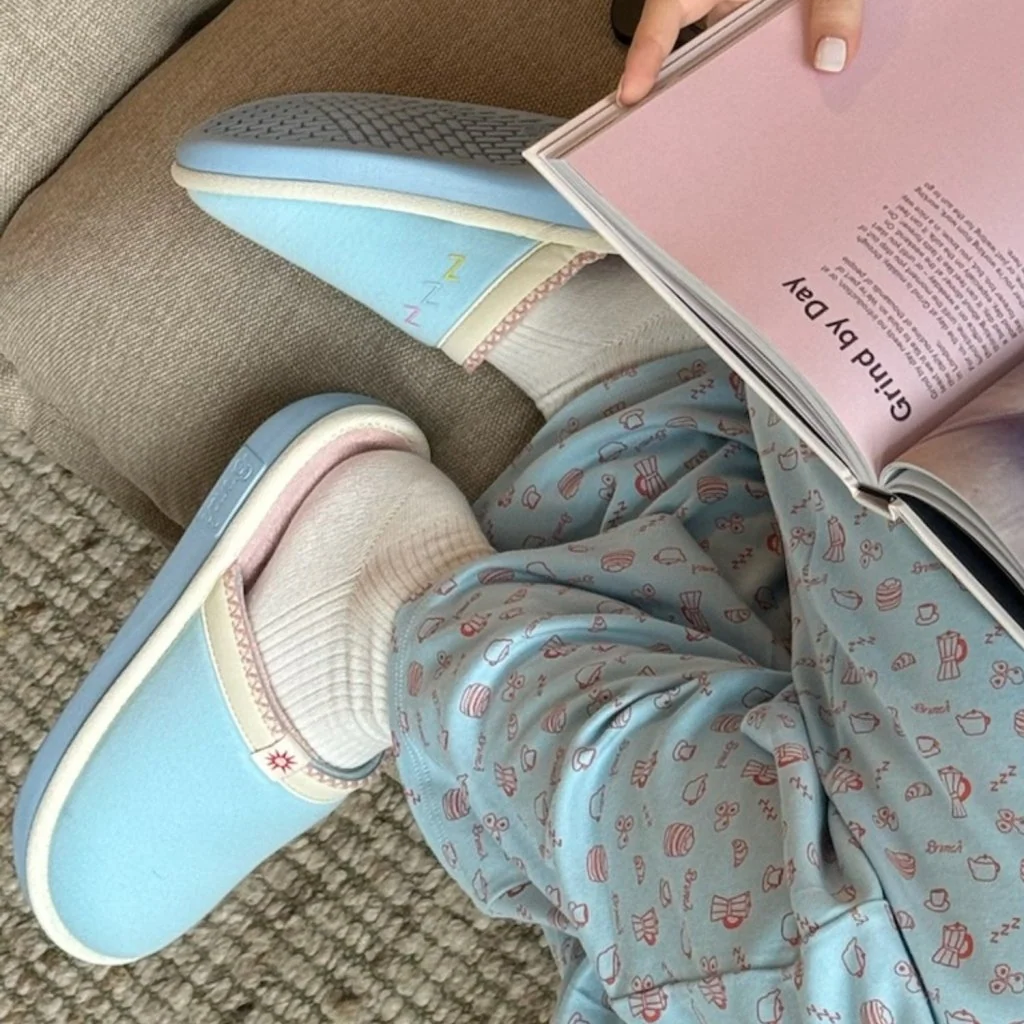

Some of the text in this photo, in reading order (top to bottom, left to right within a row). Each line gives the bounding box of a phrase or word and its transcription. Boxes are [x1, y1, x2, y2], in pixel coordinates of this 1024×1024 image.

[781, 277, 912, 422] Grind by Day
